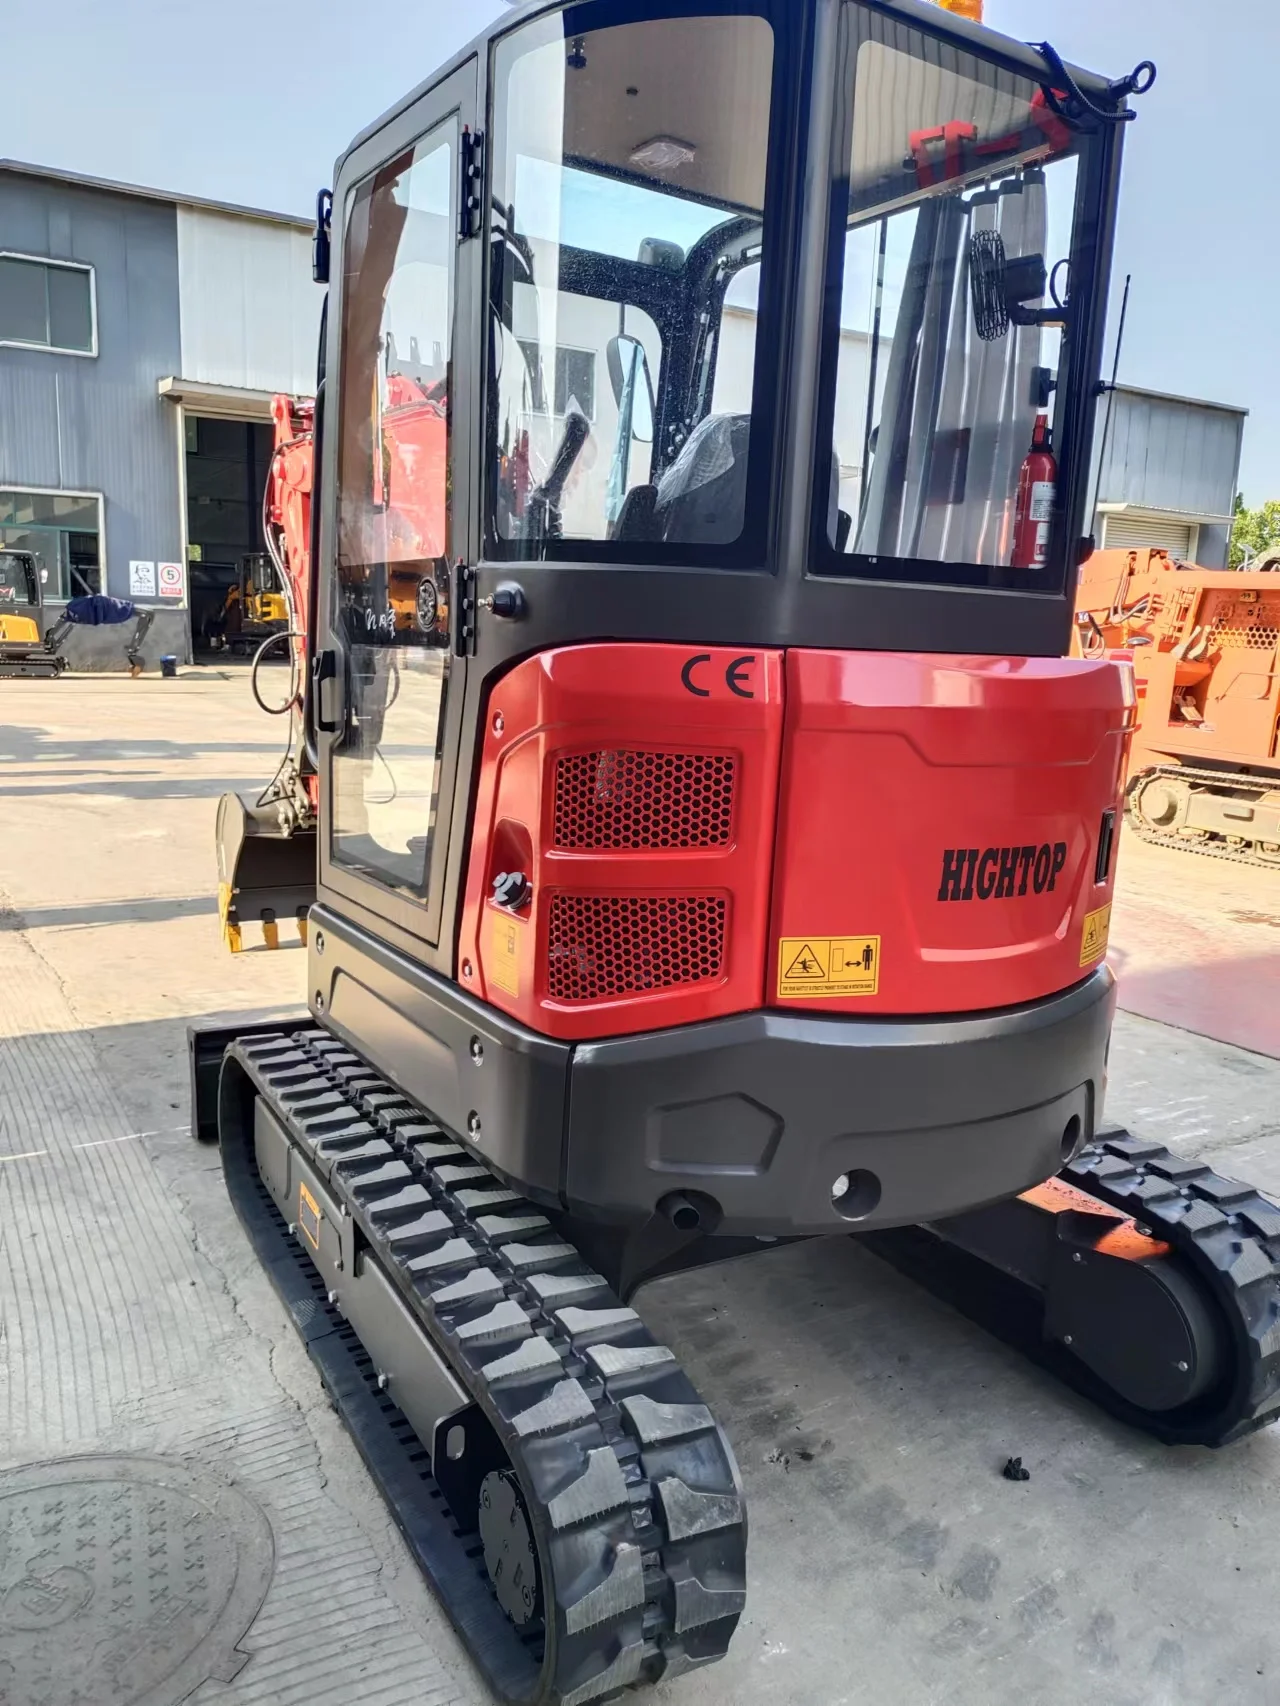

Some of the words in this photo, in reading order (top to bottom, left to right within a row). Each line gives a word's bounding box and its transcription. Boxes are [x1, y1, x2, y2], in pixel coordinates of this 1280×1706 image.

[167, 569, 175, 581] 5
[681, 654, 755, 698] CE
[937, 841, 1067, 901] HIGHTOP
